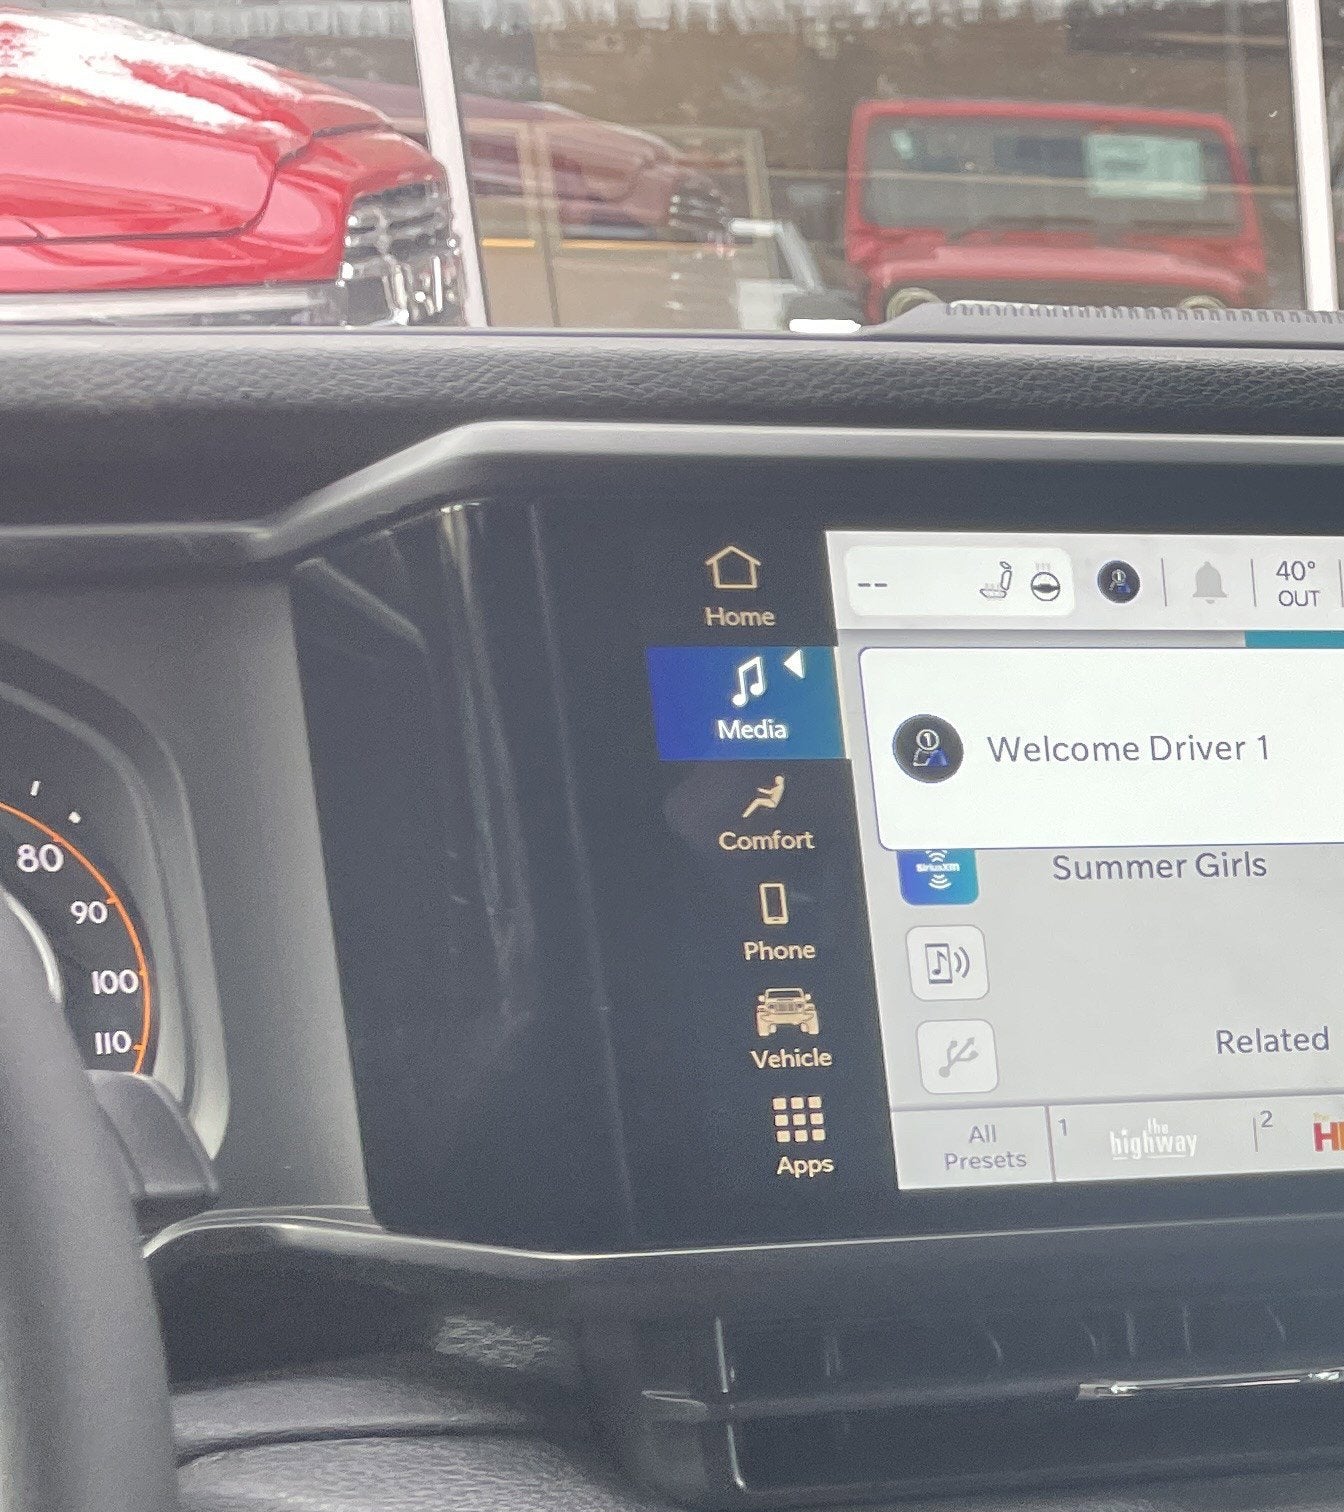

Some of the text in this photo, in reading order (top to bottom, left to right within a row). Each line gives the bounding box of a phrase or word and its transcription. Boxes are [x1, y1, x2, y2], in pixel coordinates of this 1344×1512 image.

[1275, 559, 1316, 582] 40°
[1278, 590, 1320, 608] OUT
[704, 607, 776, 627] Home
[717, 718, 789, 740] Media
[987, 735, 1270, 763] Welcome Driver 1
[718, 830, 815, 851] Comfort
[16, 842, 64, 873] 80
[1052, 851, 1268, 882] Summer Girls
[70, 900, 109, 925] 90
[743, 941, 816, 961] Phone
[92, 968, 139, 995] 100
[94, 1030, 132, 1056] 110
[1215, 1026, 1330, 1055] Related
[750, 1047, 833, 1069] Vehicle
[1058, 1117, 1068, 1136] 1
[1147, 1117, 1169, 1134] the
[1260, 1110, 1273, 1129] 2
[968, 1124, 997, 1144] All
[1109, 1127, 1197, 1159] highway
[776, 1156, 835, 1178] Apps
[944, 1150, 1028, 1171] Presets
